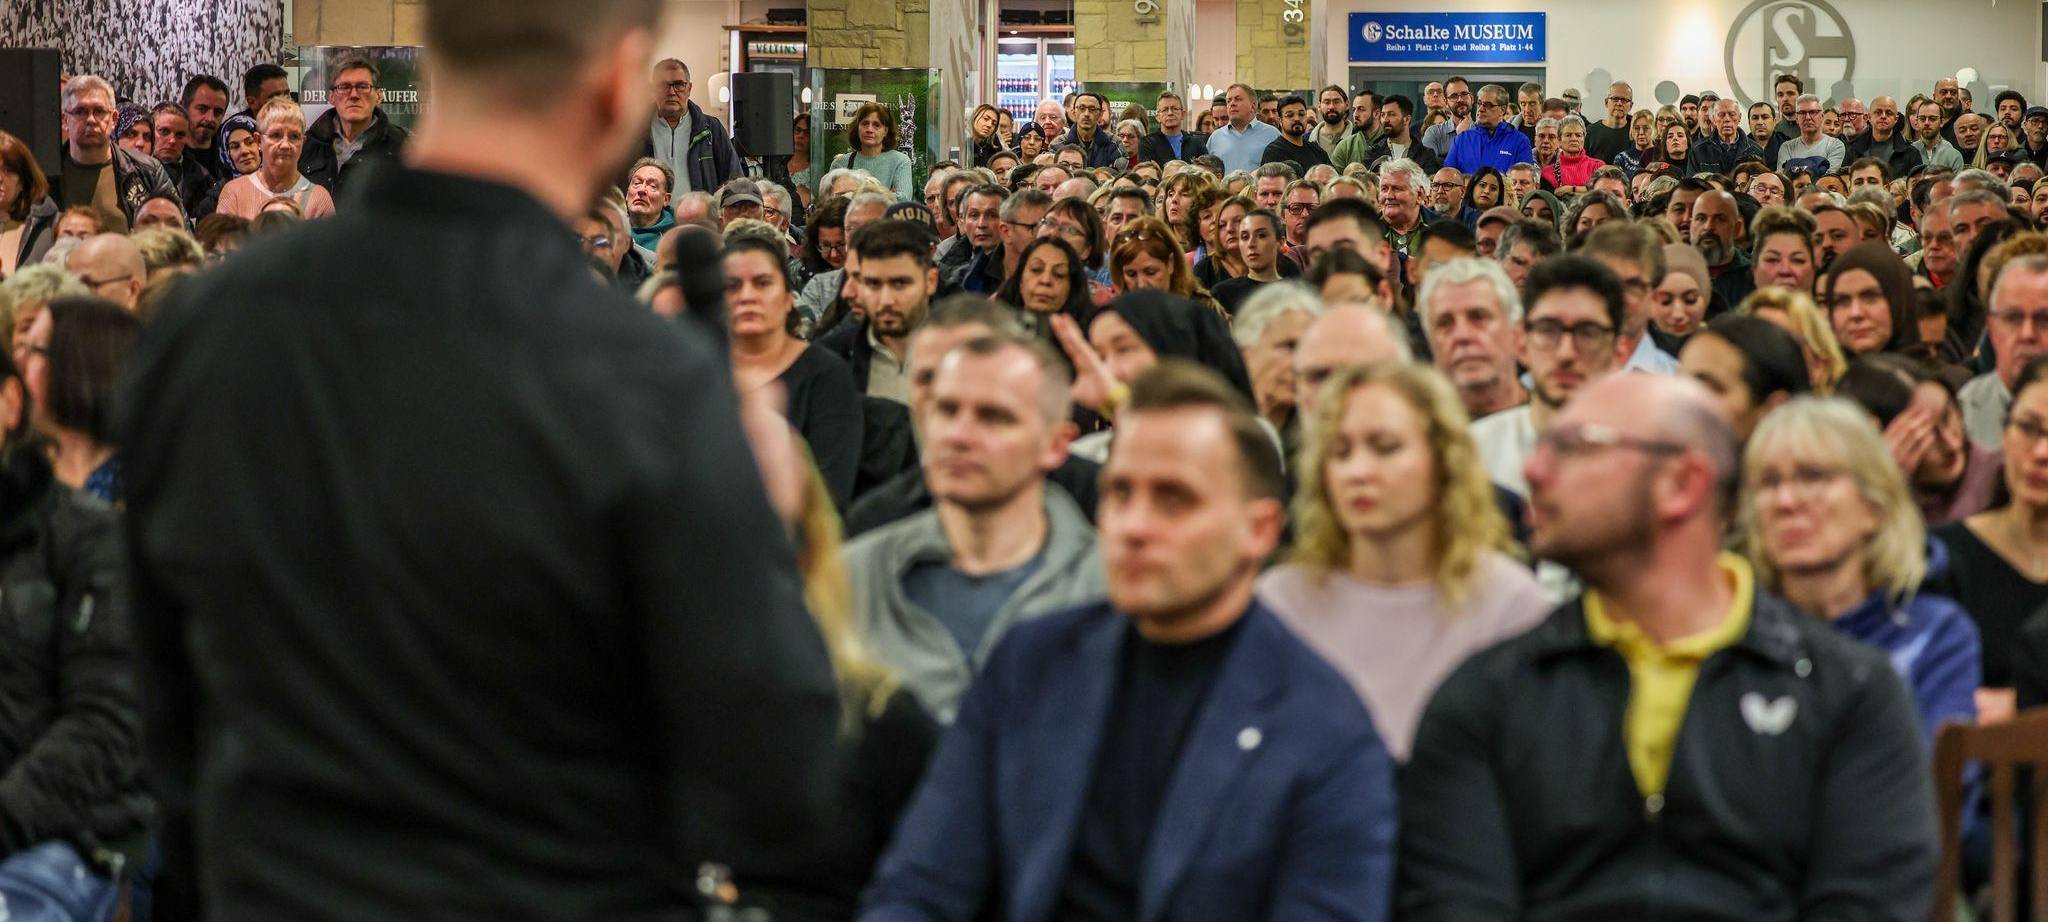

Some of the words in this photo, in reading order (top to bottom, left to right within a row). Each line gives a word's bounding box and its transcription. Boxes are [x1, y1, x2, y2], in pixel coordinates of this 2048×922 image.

[1385, 24, 1450, 40] Schalke
[1454, 24, 1534, 40] MUSEUM
[1386, 43, 1406, 52] Reihe
[1407, 43, 1412, 52] 1
[1415, 43, 1432, 52] Platz
[1453, 43, 1467, 52] und
[1470, 43, 1490, 52] Reihe
[1491, 43, 1497, 52] 2
[1500, 43, 1517, 52] Platz
[303, 89, 327, 103] DER
[892, 206, 930, 225] MOIN
